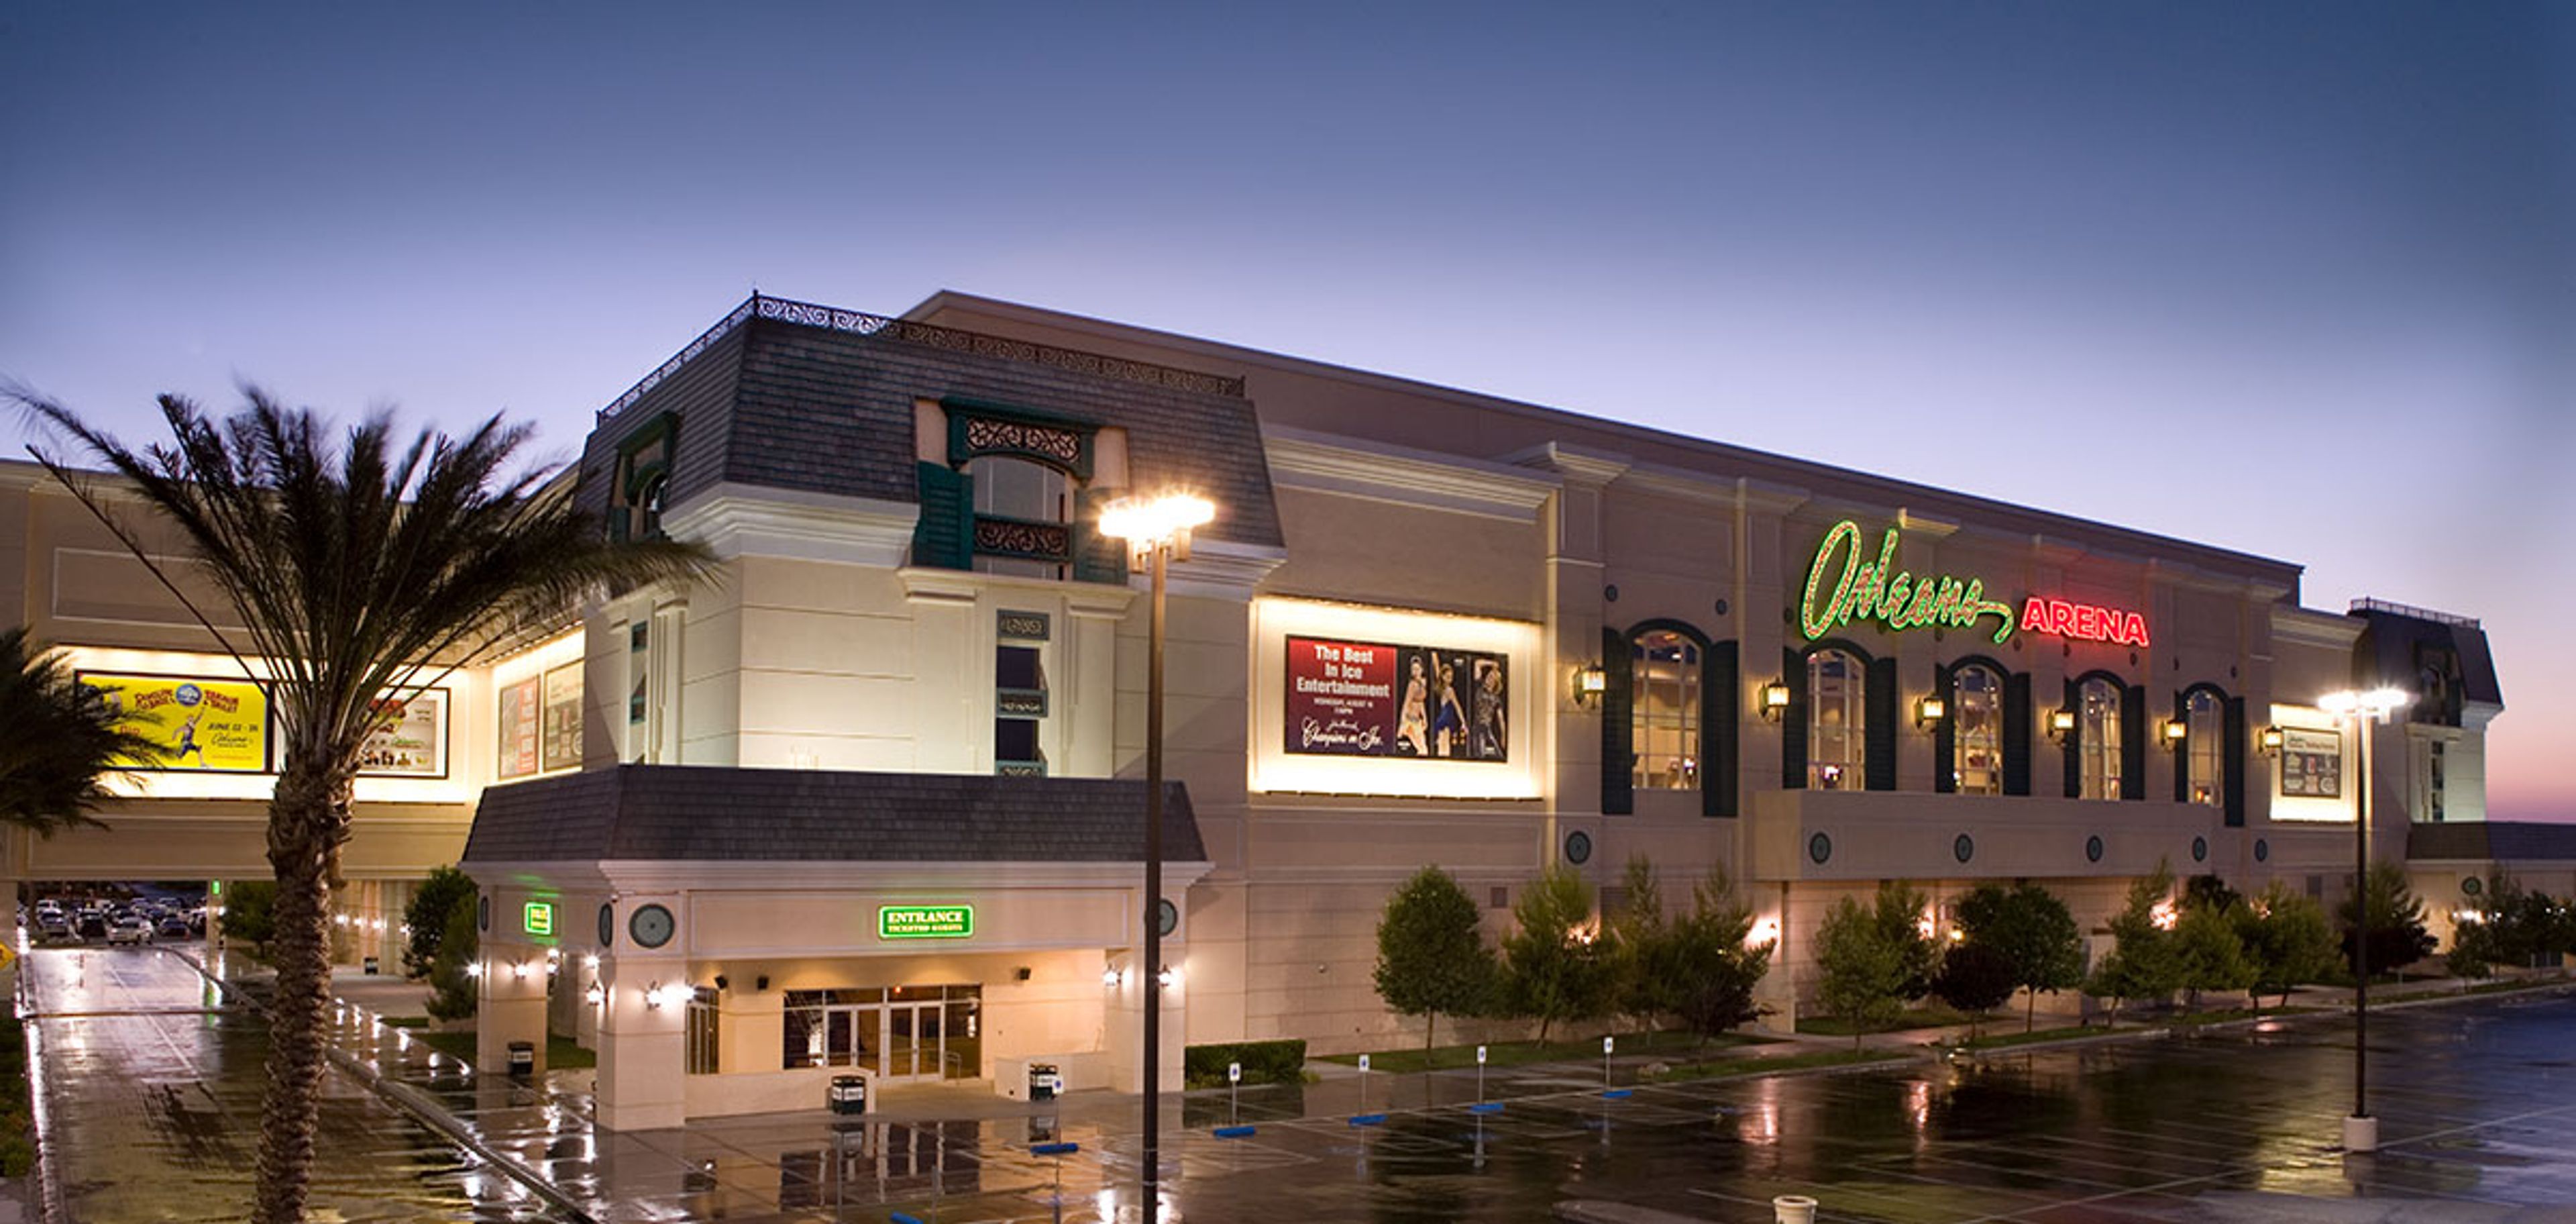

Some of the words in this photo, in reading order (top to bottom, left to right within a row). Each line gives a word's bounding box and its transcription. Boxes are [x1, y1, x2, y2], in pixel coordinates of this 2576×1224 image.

[1802, 521, 2013, 643] Orleans
[2021, 597, 2149, 647] ARENA
[1315, 645, 1340, 661] The
[1344, 647, 1373, 664] Best
[1325, 662, 1338, 676] In
[1342, 664, 1362, 679] Ice
[1297, 676, 1389, 697] Entertainment
[888, 911, 963, 923] ENTRANCE
